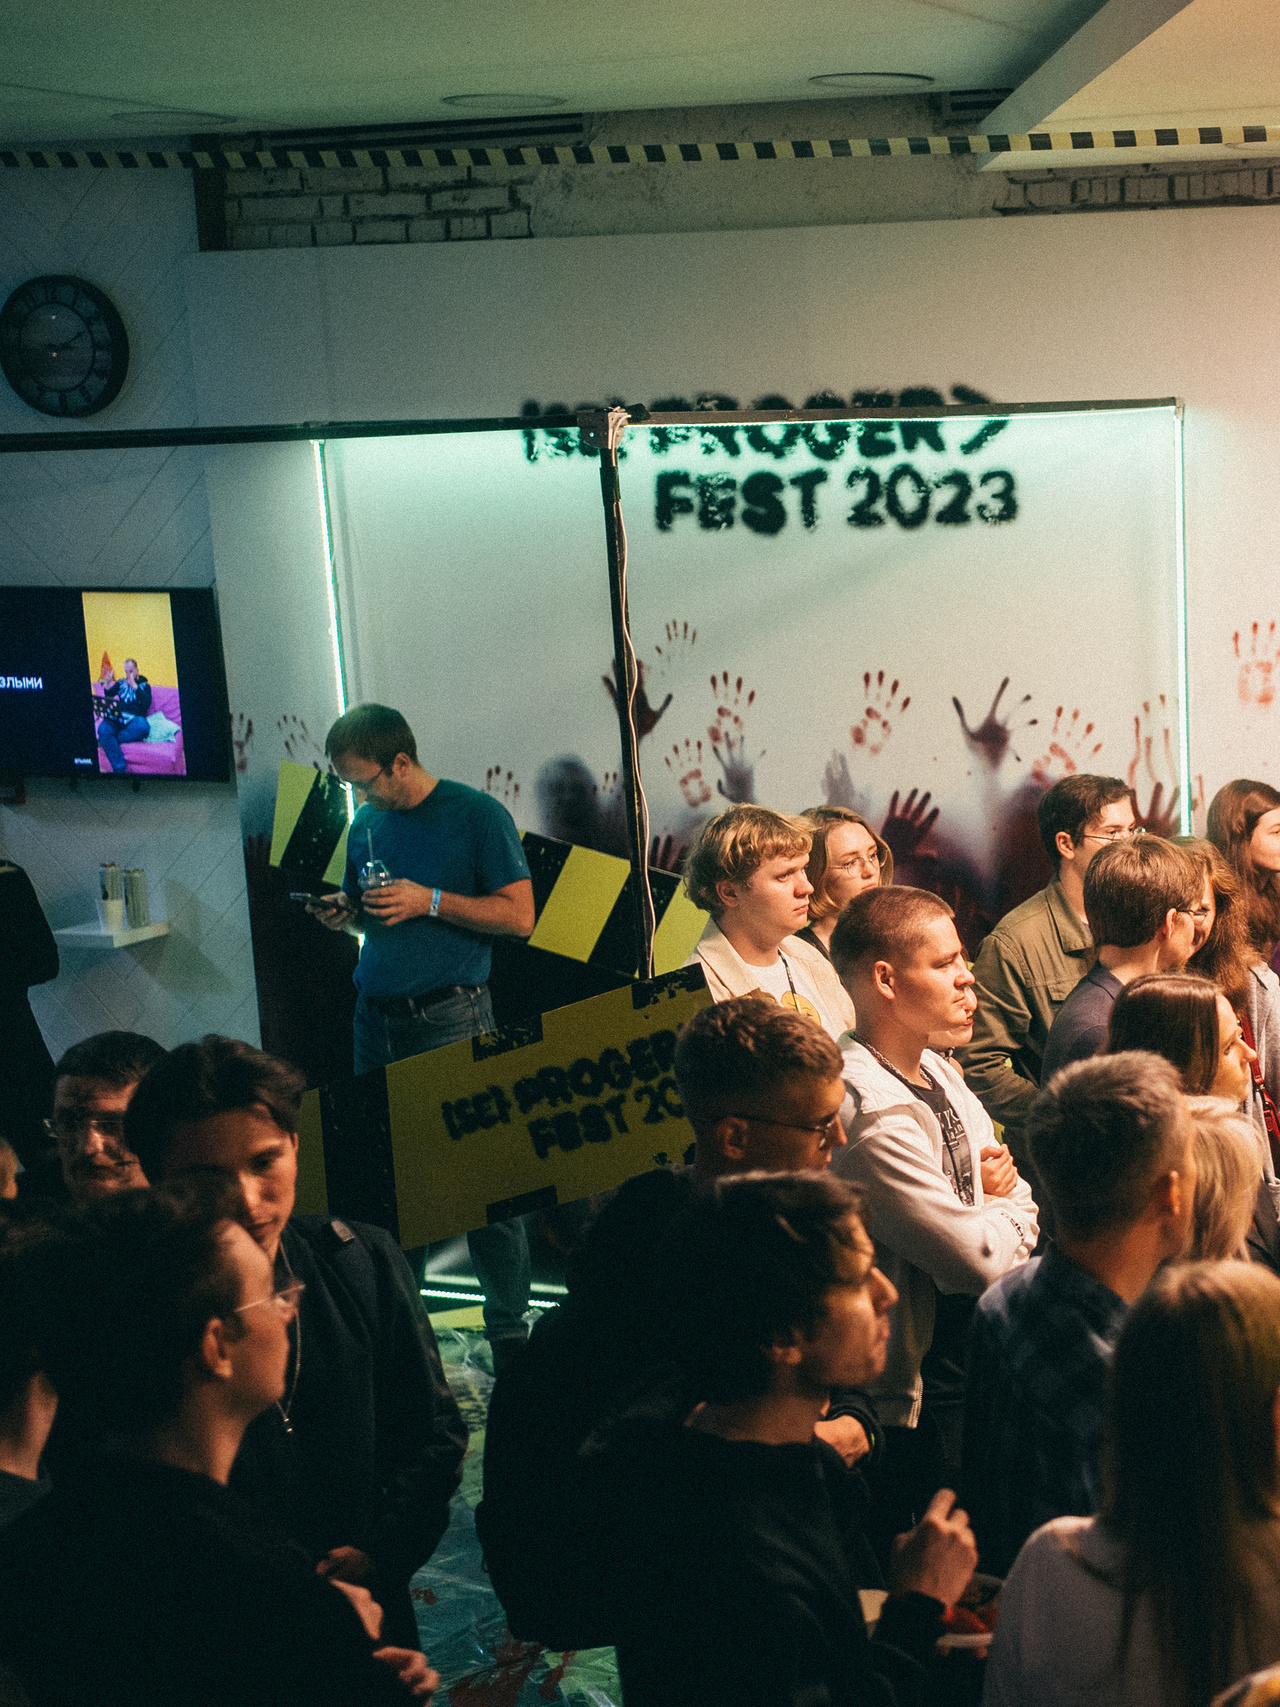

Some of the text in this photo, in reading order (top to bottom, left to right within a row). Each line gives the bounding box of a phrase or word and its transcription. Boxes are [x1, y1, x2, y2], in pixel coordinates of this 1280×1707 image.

[655, 462, 1019, 534] FEST 2023
[527, 1092, 630, 1160] FEST
